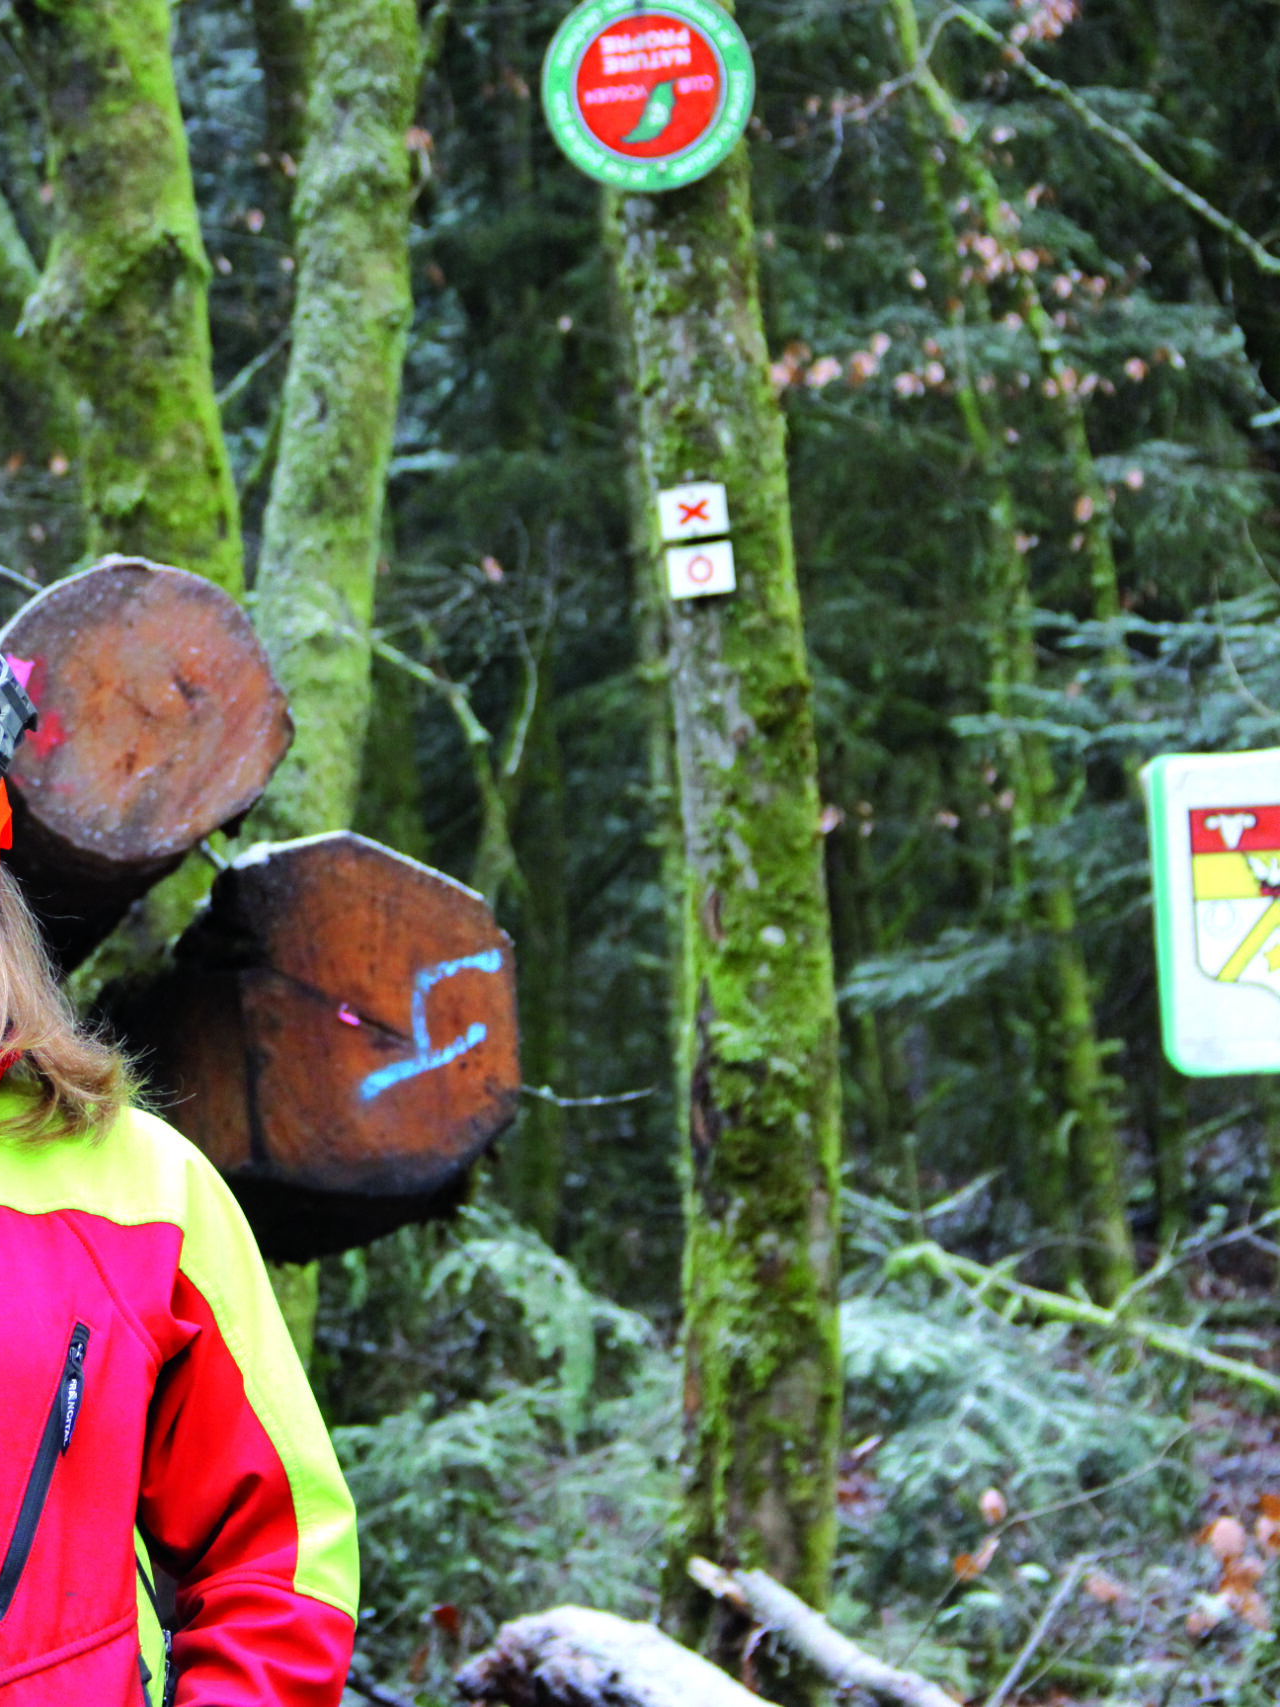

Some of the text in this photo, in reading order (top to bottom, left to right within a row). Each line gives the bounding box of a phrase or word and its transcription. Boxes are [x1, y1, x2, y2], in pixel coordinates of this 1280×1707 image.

[598, 27, 691, 55] PROPRE
[601, 47, 692, 75] NATURE
[63, 1378, 78, 1447] FRANCITAL
